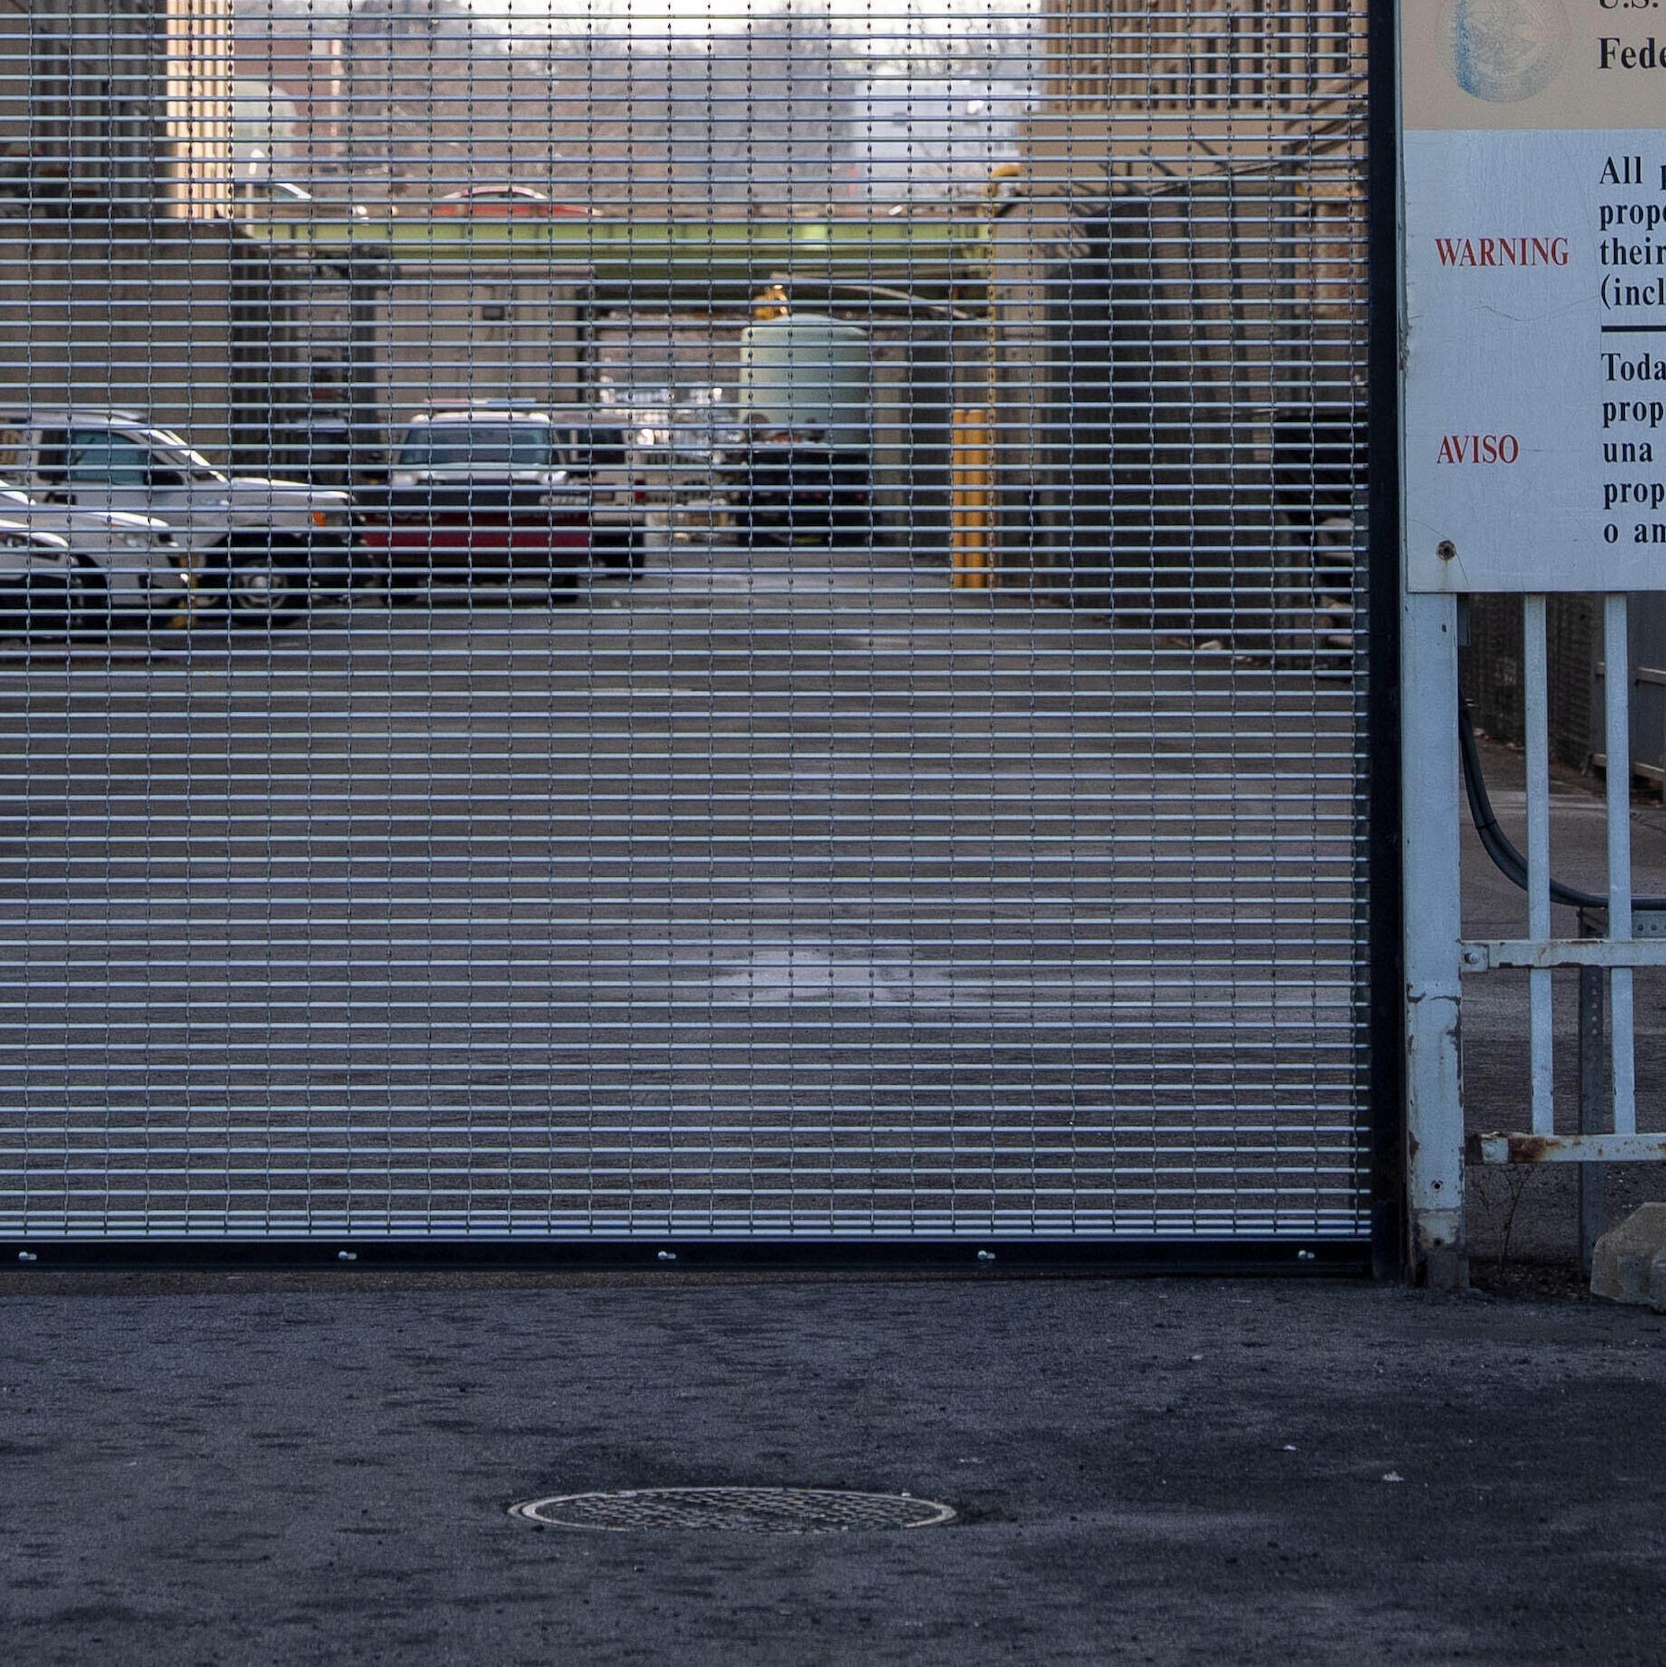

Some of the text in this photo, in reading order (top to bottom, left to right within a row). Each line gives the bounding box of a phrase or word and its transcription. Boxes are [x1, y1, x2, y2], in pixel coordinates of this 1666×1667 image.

[1599, 155, 1643, 185] All
[1436, 237, 1568, 266] WARNING
[1442, 435, 1518, 463] AVISO
[1602, 442, 1654, 463] una
[1603, 523, 1619, 544] o
